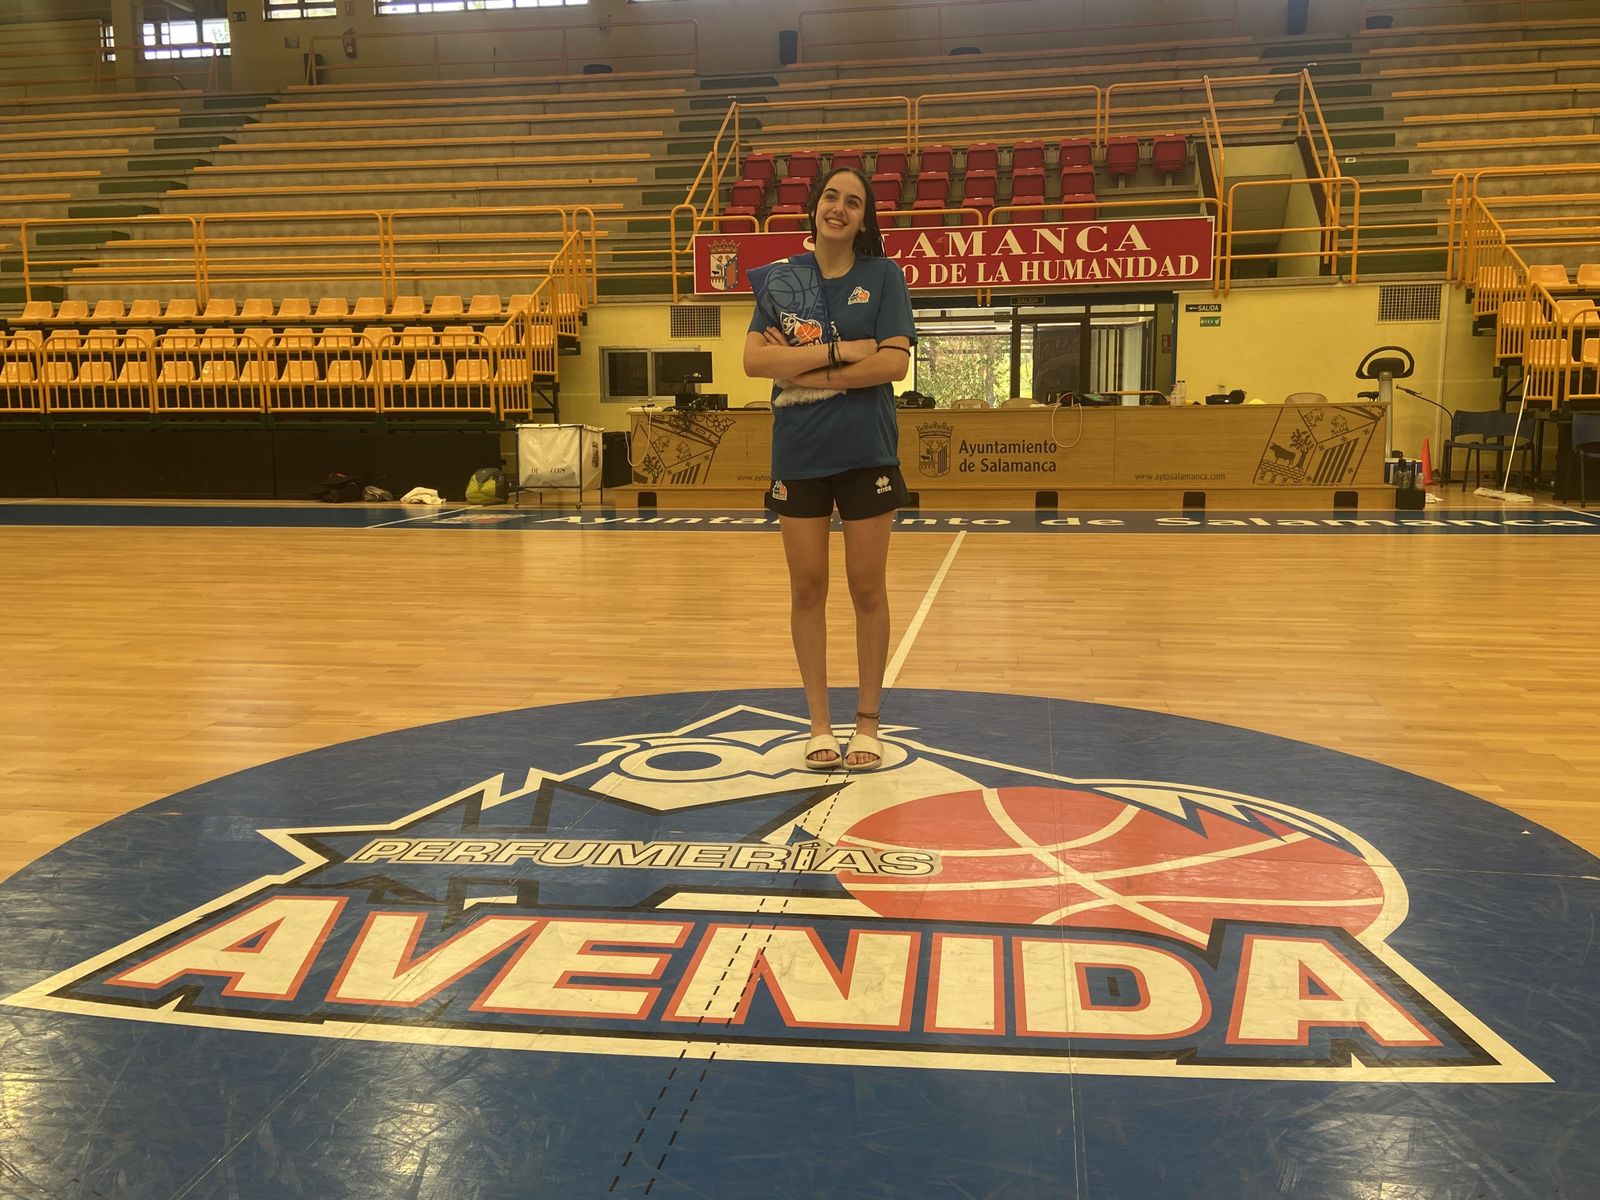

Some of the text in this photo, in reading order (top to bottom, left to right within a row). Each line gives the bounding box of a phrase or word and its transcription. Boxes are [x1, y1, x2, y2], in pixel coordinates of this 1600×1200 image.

[803, 224, 1151, 258] SLAMANCA
[929, 262, 968, 285] DE
[977, 261, 1011, 283] LA
[1020, 254, 1199, 282] HUMANIDAD
[959, 439, 1057, 457] Ayuntamiento
[959, 458, 1057, 472] de Salamanca
[1134, 472, 1226, 482] www.aytosalamanca.com
[1040, 517, 1125, 526] de
[1155, 517, 1597, 526] Salamanca
[345, 837, 942, 877] PERFUMERÍAS
[103, 895, 1444, 1047] AVENIDA
